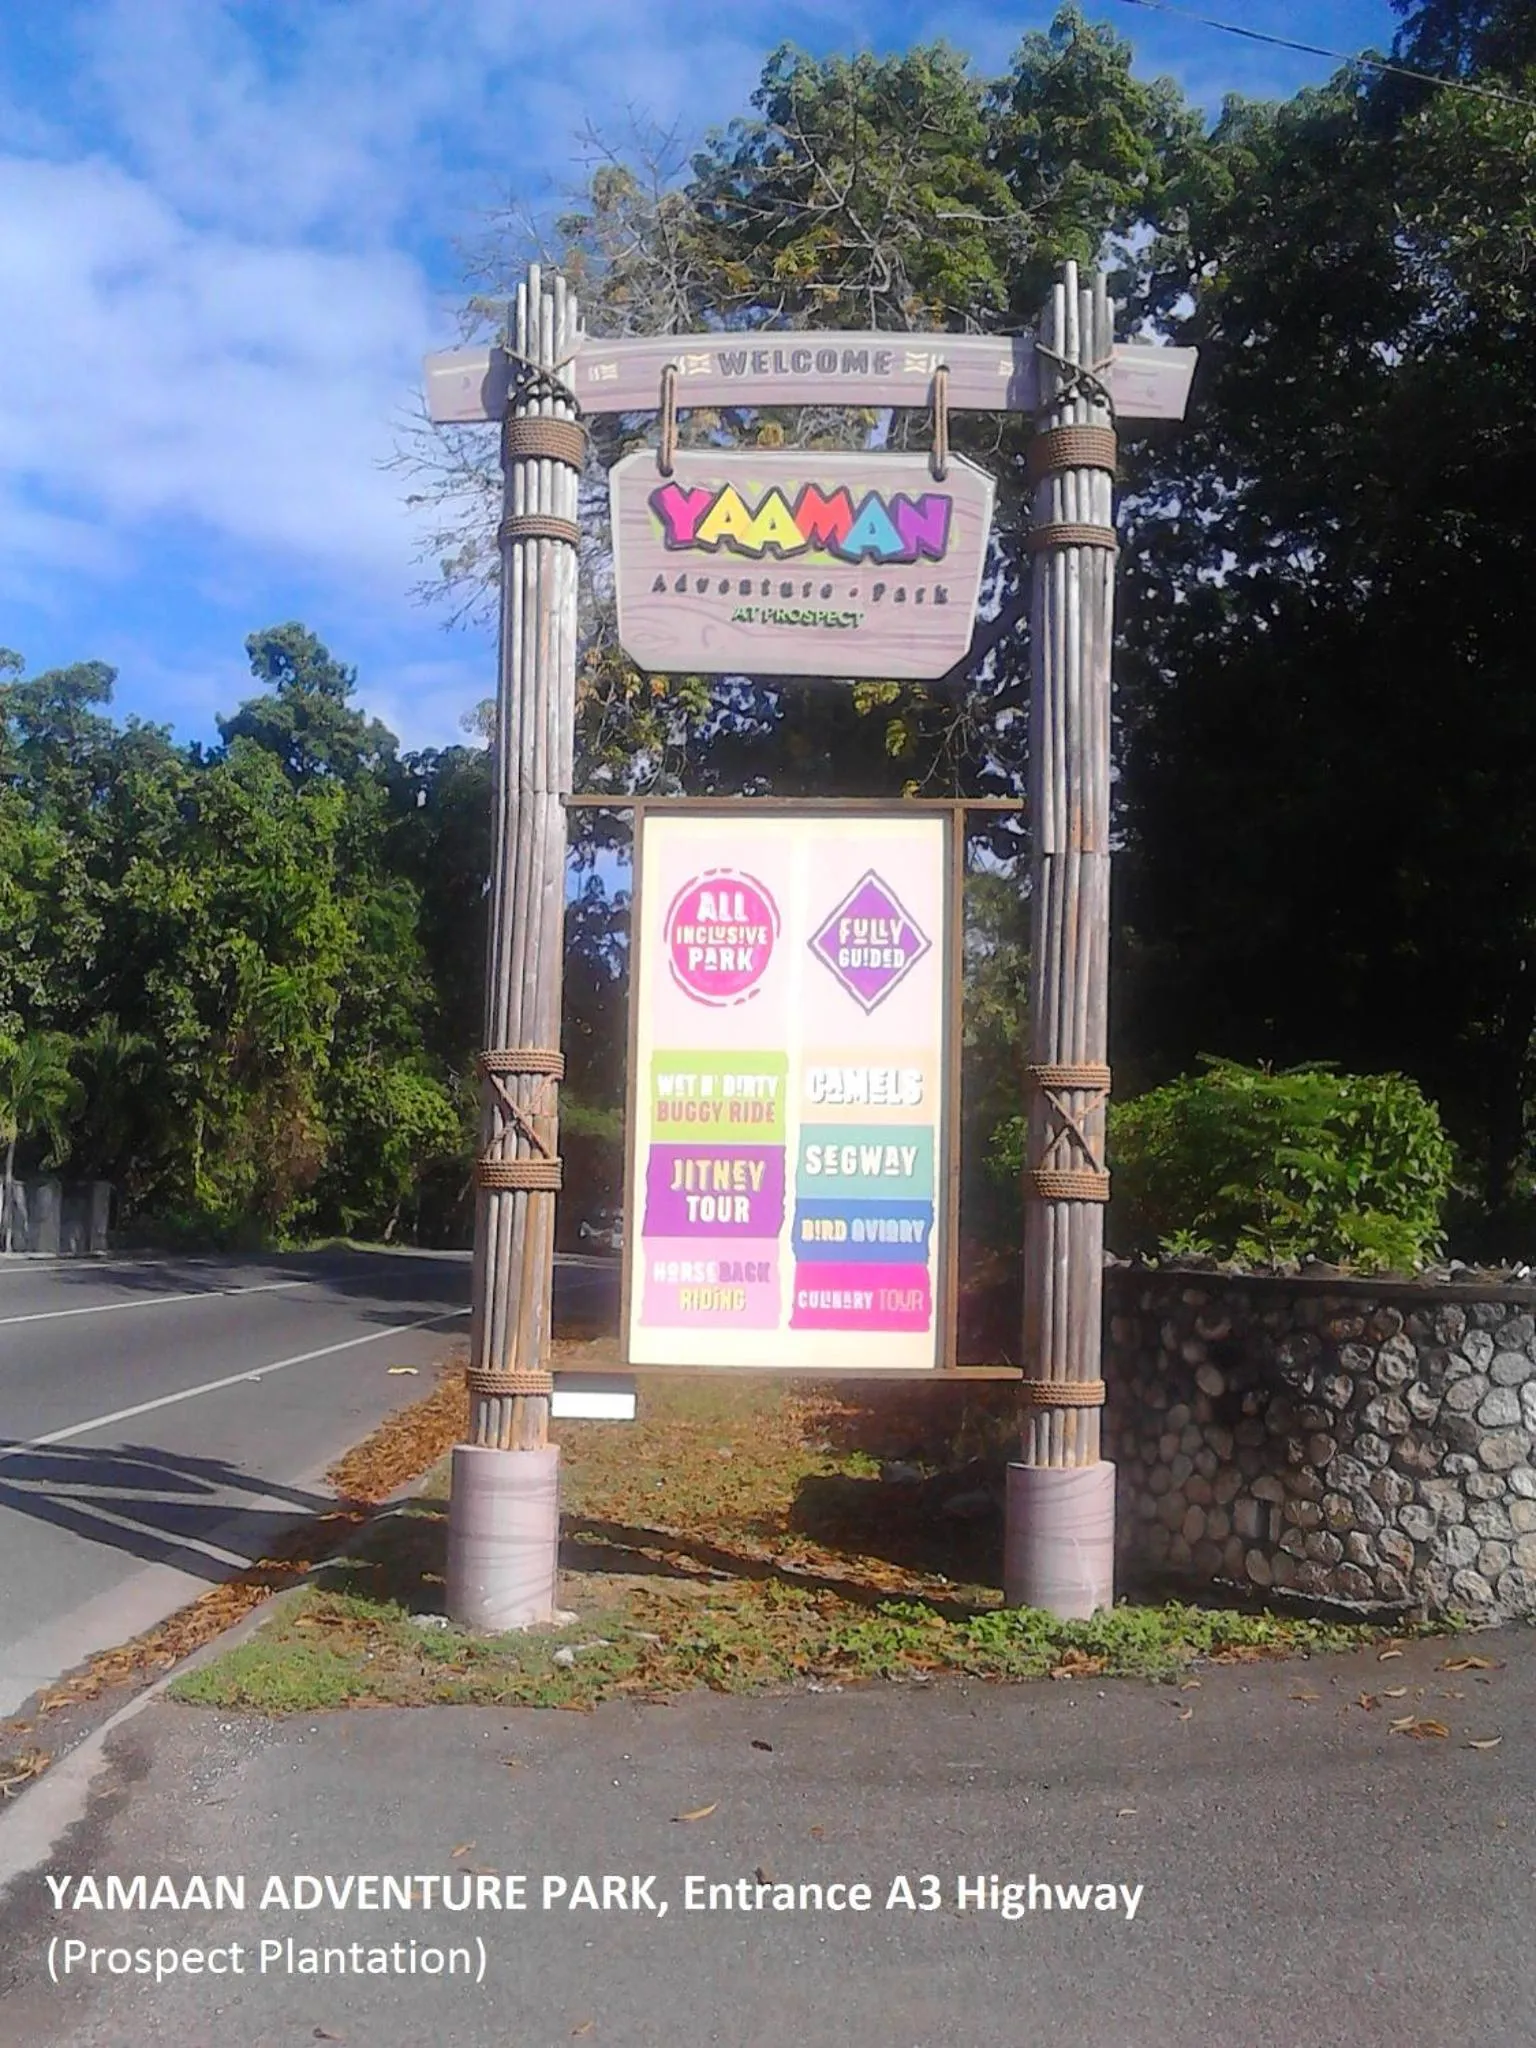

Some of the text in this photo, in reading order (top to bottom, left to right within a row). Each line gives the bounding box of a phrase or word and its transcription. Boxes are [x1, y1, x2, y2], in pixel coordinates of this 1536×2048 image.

[717, 350, 893, 376] WELCOME
[649, 481, 953, 564] YAAMAN
[732, 607, 863, 628] AT PROSPECT
[696, 890, 749, 922] ALL
[676, 925, 768, 945] INCLUSIVE
[839, 917, 904, 945] FULLY
[688, 946, 753, 972] PARK
[838, 948, 905, 969] GUIDED
[807, 1067, 923, 1105] CAMELS
[656, 1100, 776, 1124] BUGGY RIDE
[805, 1144, 917, 1177] SEGWAY
[670, 1159, 765, 1192] JITNEY
[686, 1195, 750, 1224] TOUR
[801, 1218, 847, 1242] BIRD
[679, 1286, 747, 1312] RIDING
[879, 1288, 923, 1312] TOUR
